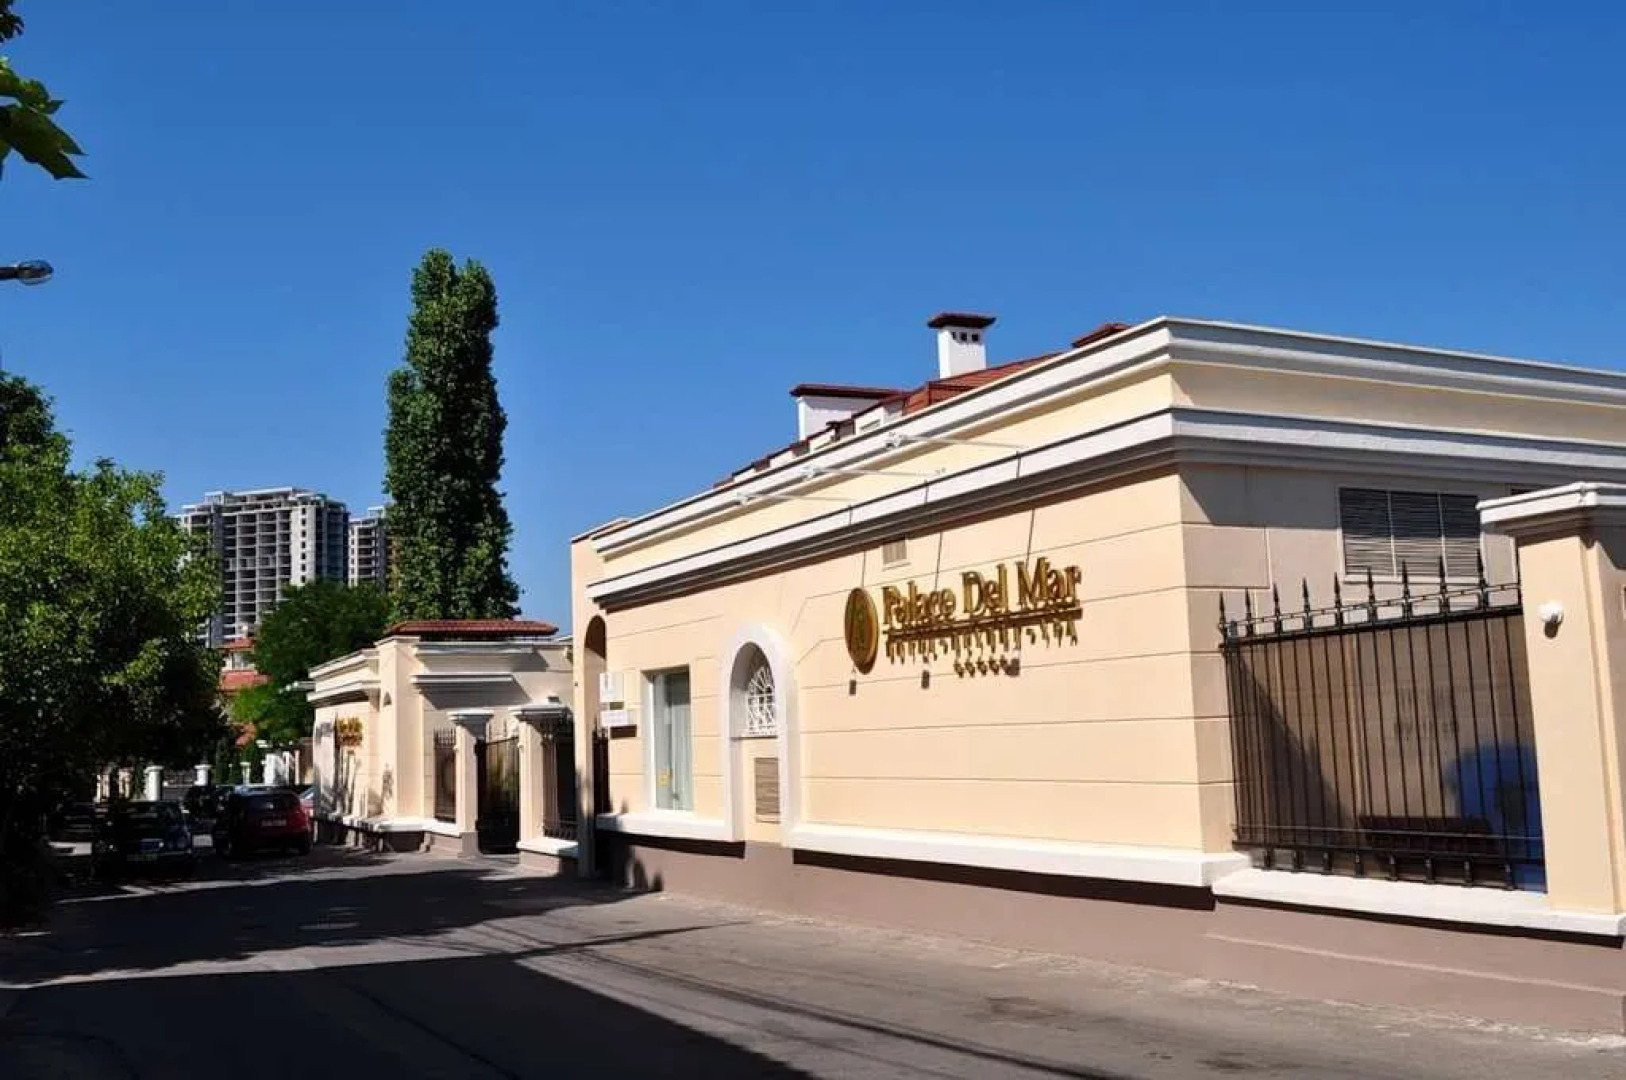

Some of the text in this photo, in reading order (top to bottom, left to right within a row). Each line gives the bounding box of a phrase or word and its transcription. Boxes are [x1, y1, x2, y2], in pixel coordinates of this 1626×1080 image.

[882, 556, 1081, 624] Palace Del Mar
